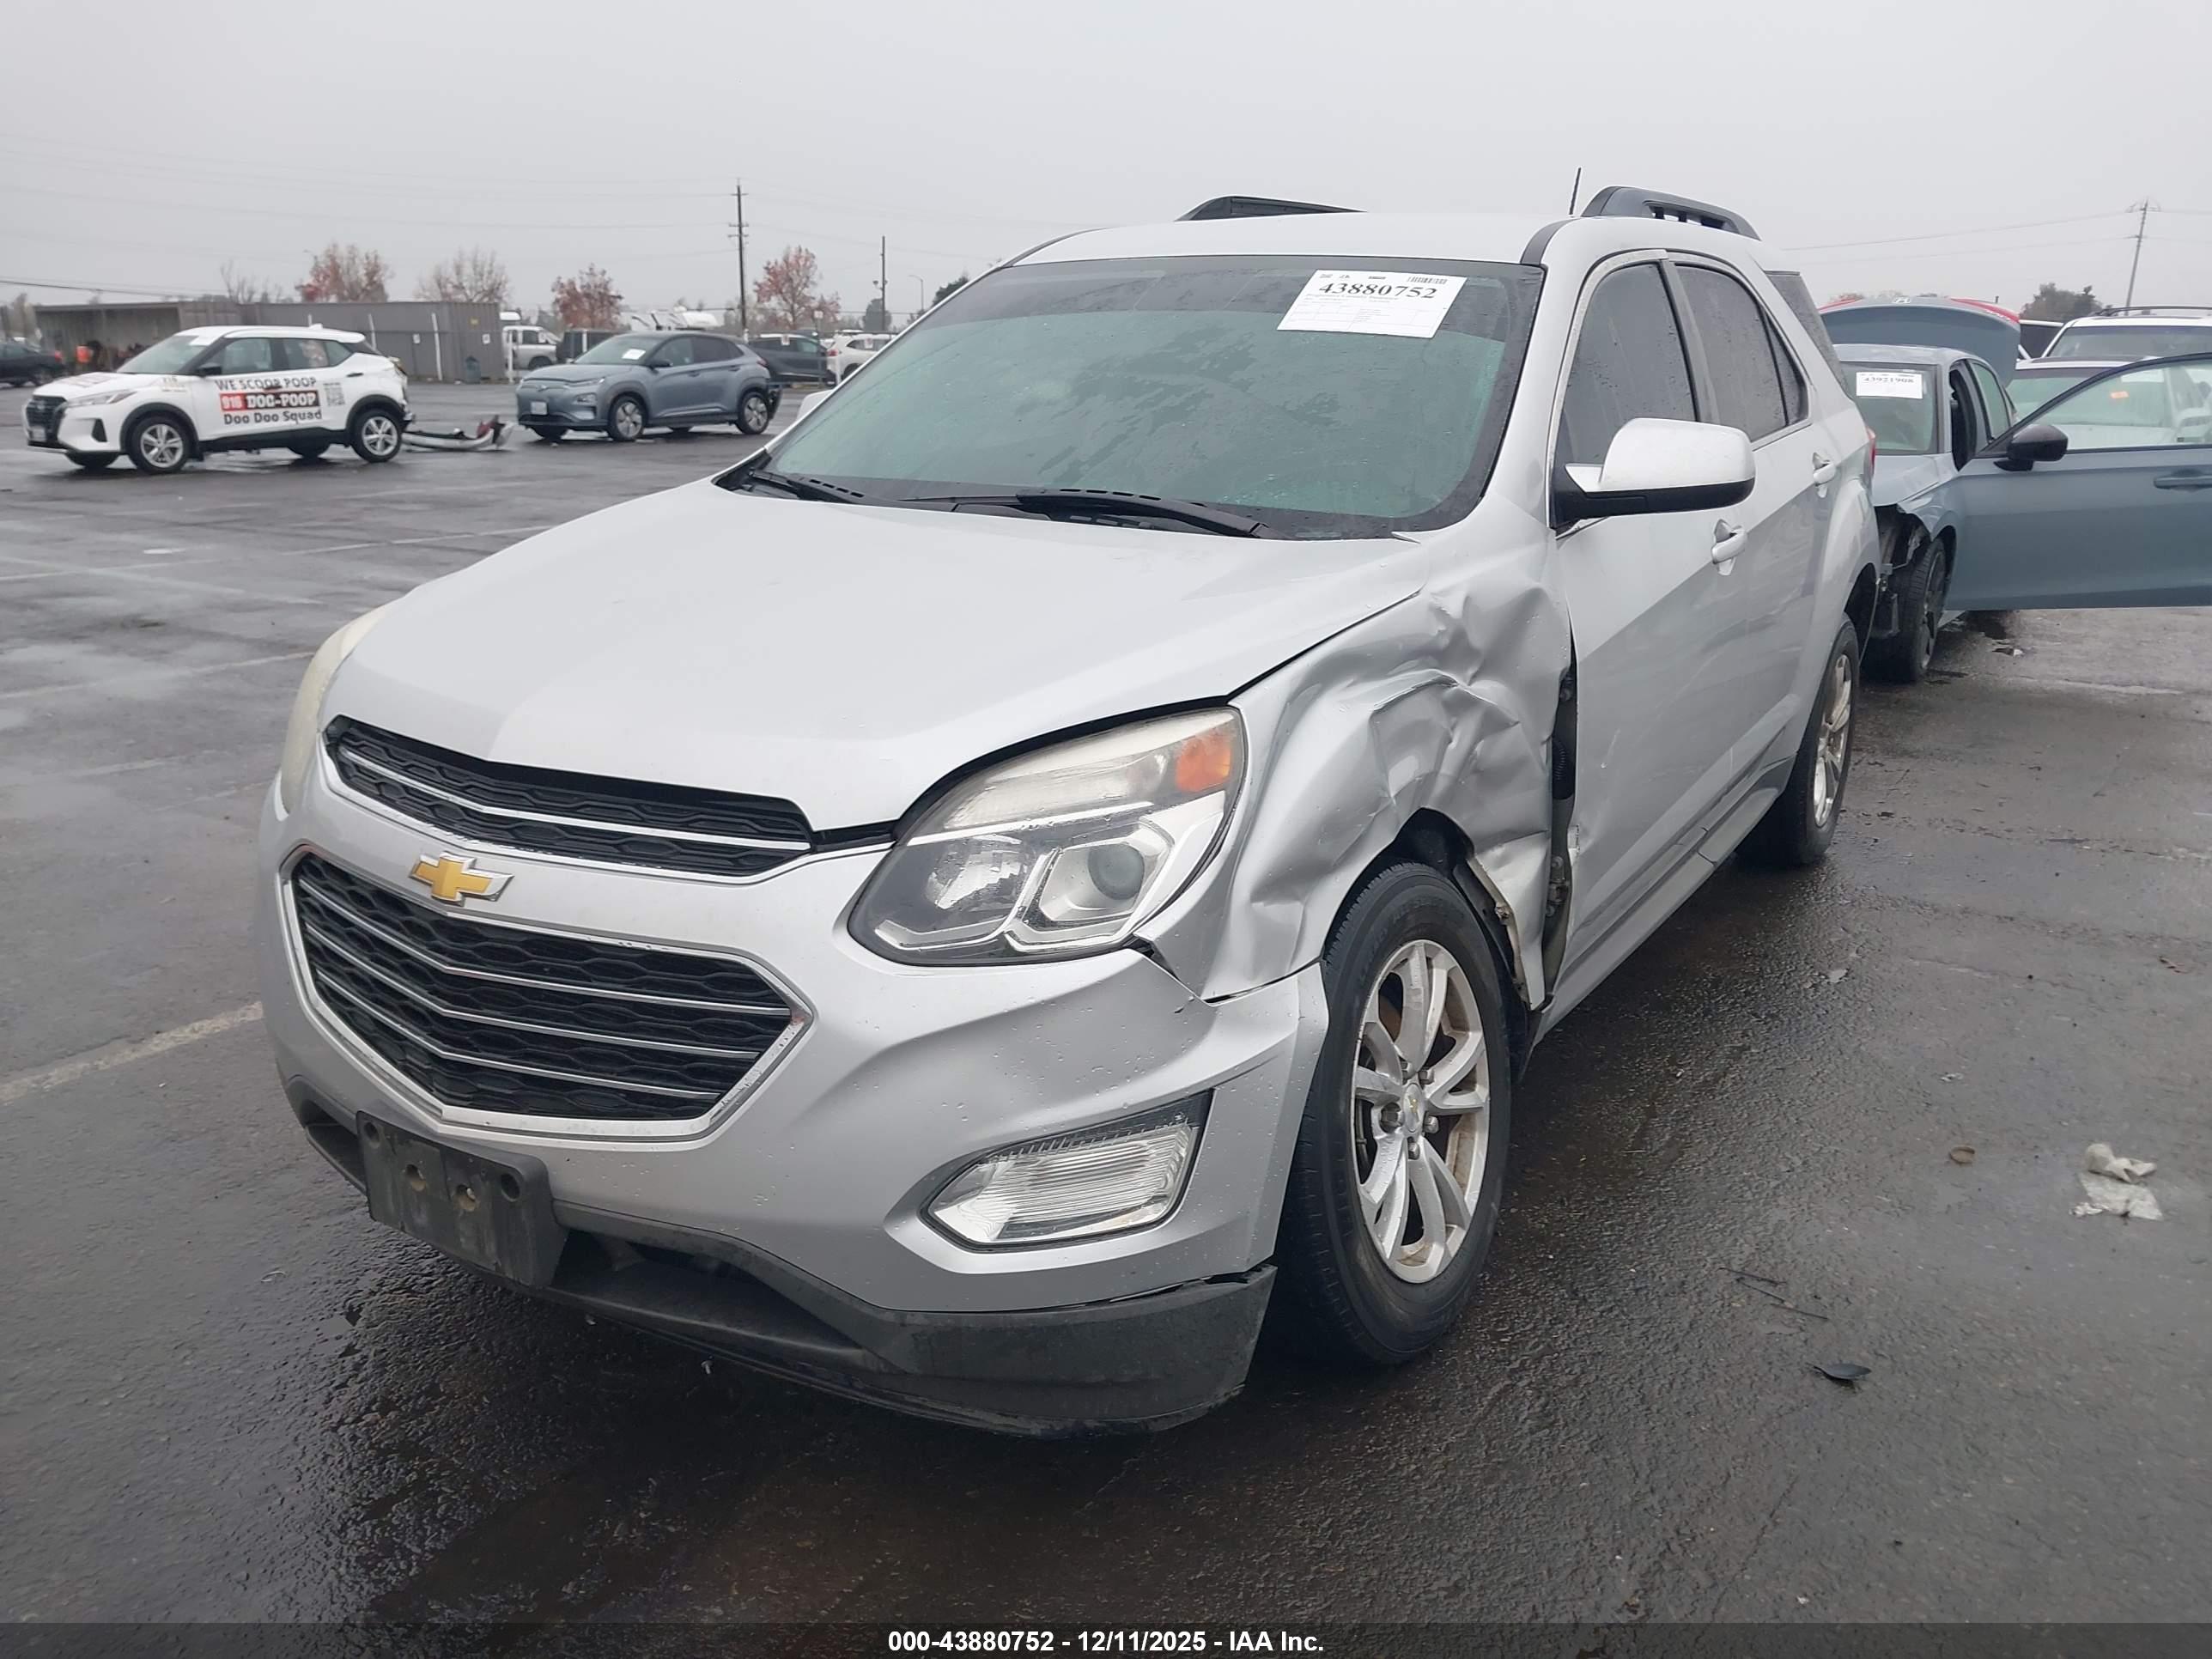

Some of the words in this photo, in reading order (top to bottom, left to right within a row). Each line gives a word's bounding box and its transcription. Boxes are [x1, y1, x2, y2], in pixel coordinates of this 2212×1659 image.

[1319, 283, 1437, 299] 43880752
[215, 380, 236, 390] WE
[239, 379, 280, 390] SCOOP
[283, 377, 317, 387] POOP
[246, 392, 317, 408] DOG-POOP
[224, 413, 250, 424] Doo
[254, 412, 279, 423] Doo
[283, 409, 322, 424] Squad
